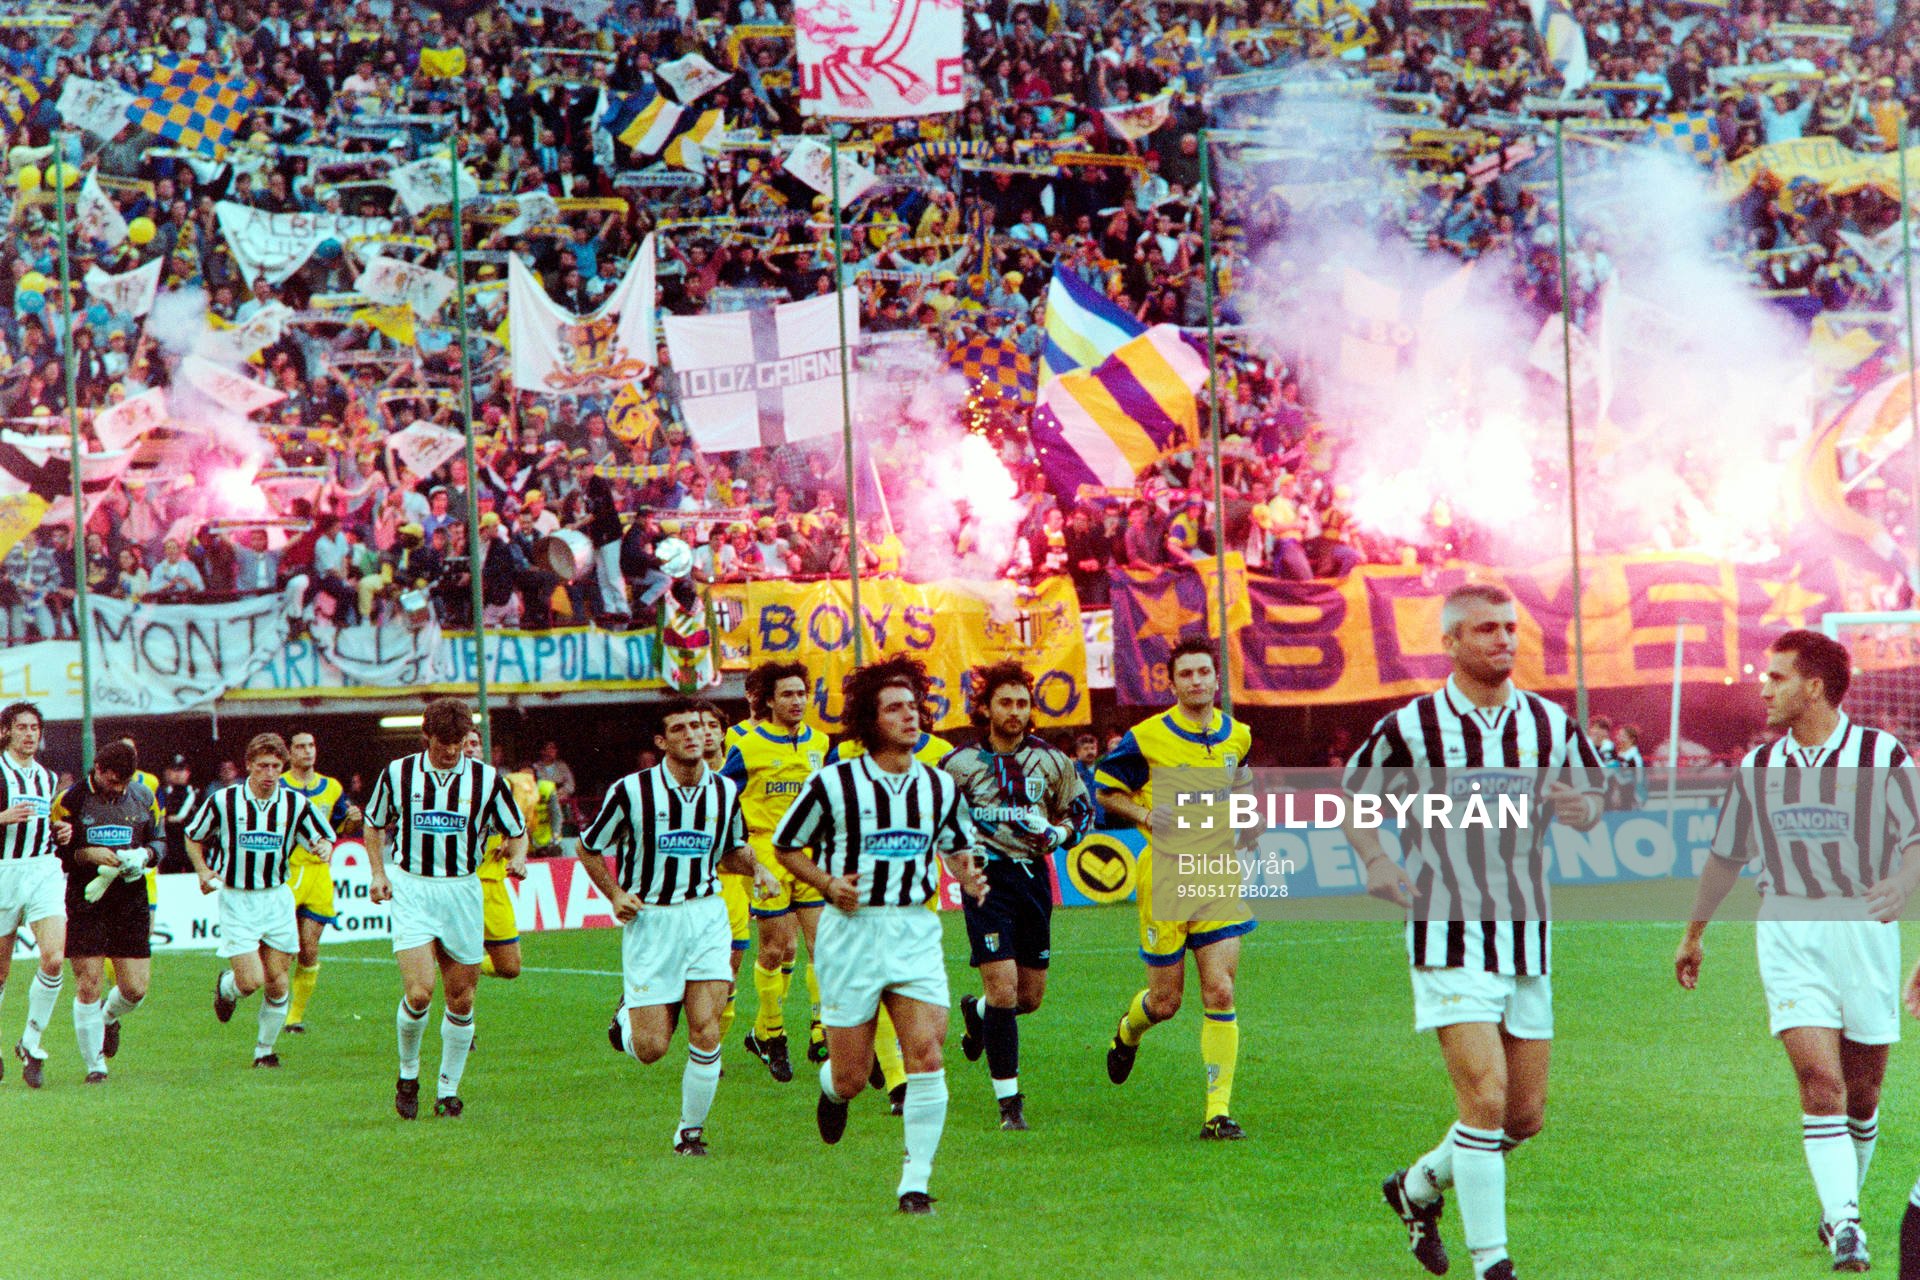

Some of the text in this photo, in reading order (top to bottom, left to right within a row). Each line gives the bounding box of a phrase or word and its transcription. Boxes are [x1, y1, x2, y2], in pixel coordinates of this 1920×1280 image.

[758, 603, 938, 653] BOYS
[1142, 661, 1169, 692] 19
[766, 780, 804, 794] parm
[1453, 777, 1529, 796] DANONE
[415, 815, 466, 828] DANONE
[1774, 812, 1847, 831] DANONE
[89, 828, 132, 840] DANONE
[240, 834, 282, 846] DANONE
[660, 836, 712, 849] DANONE
[333, 880, 367, 898] Ma
